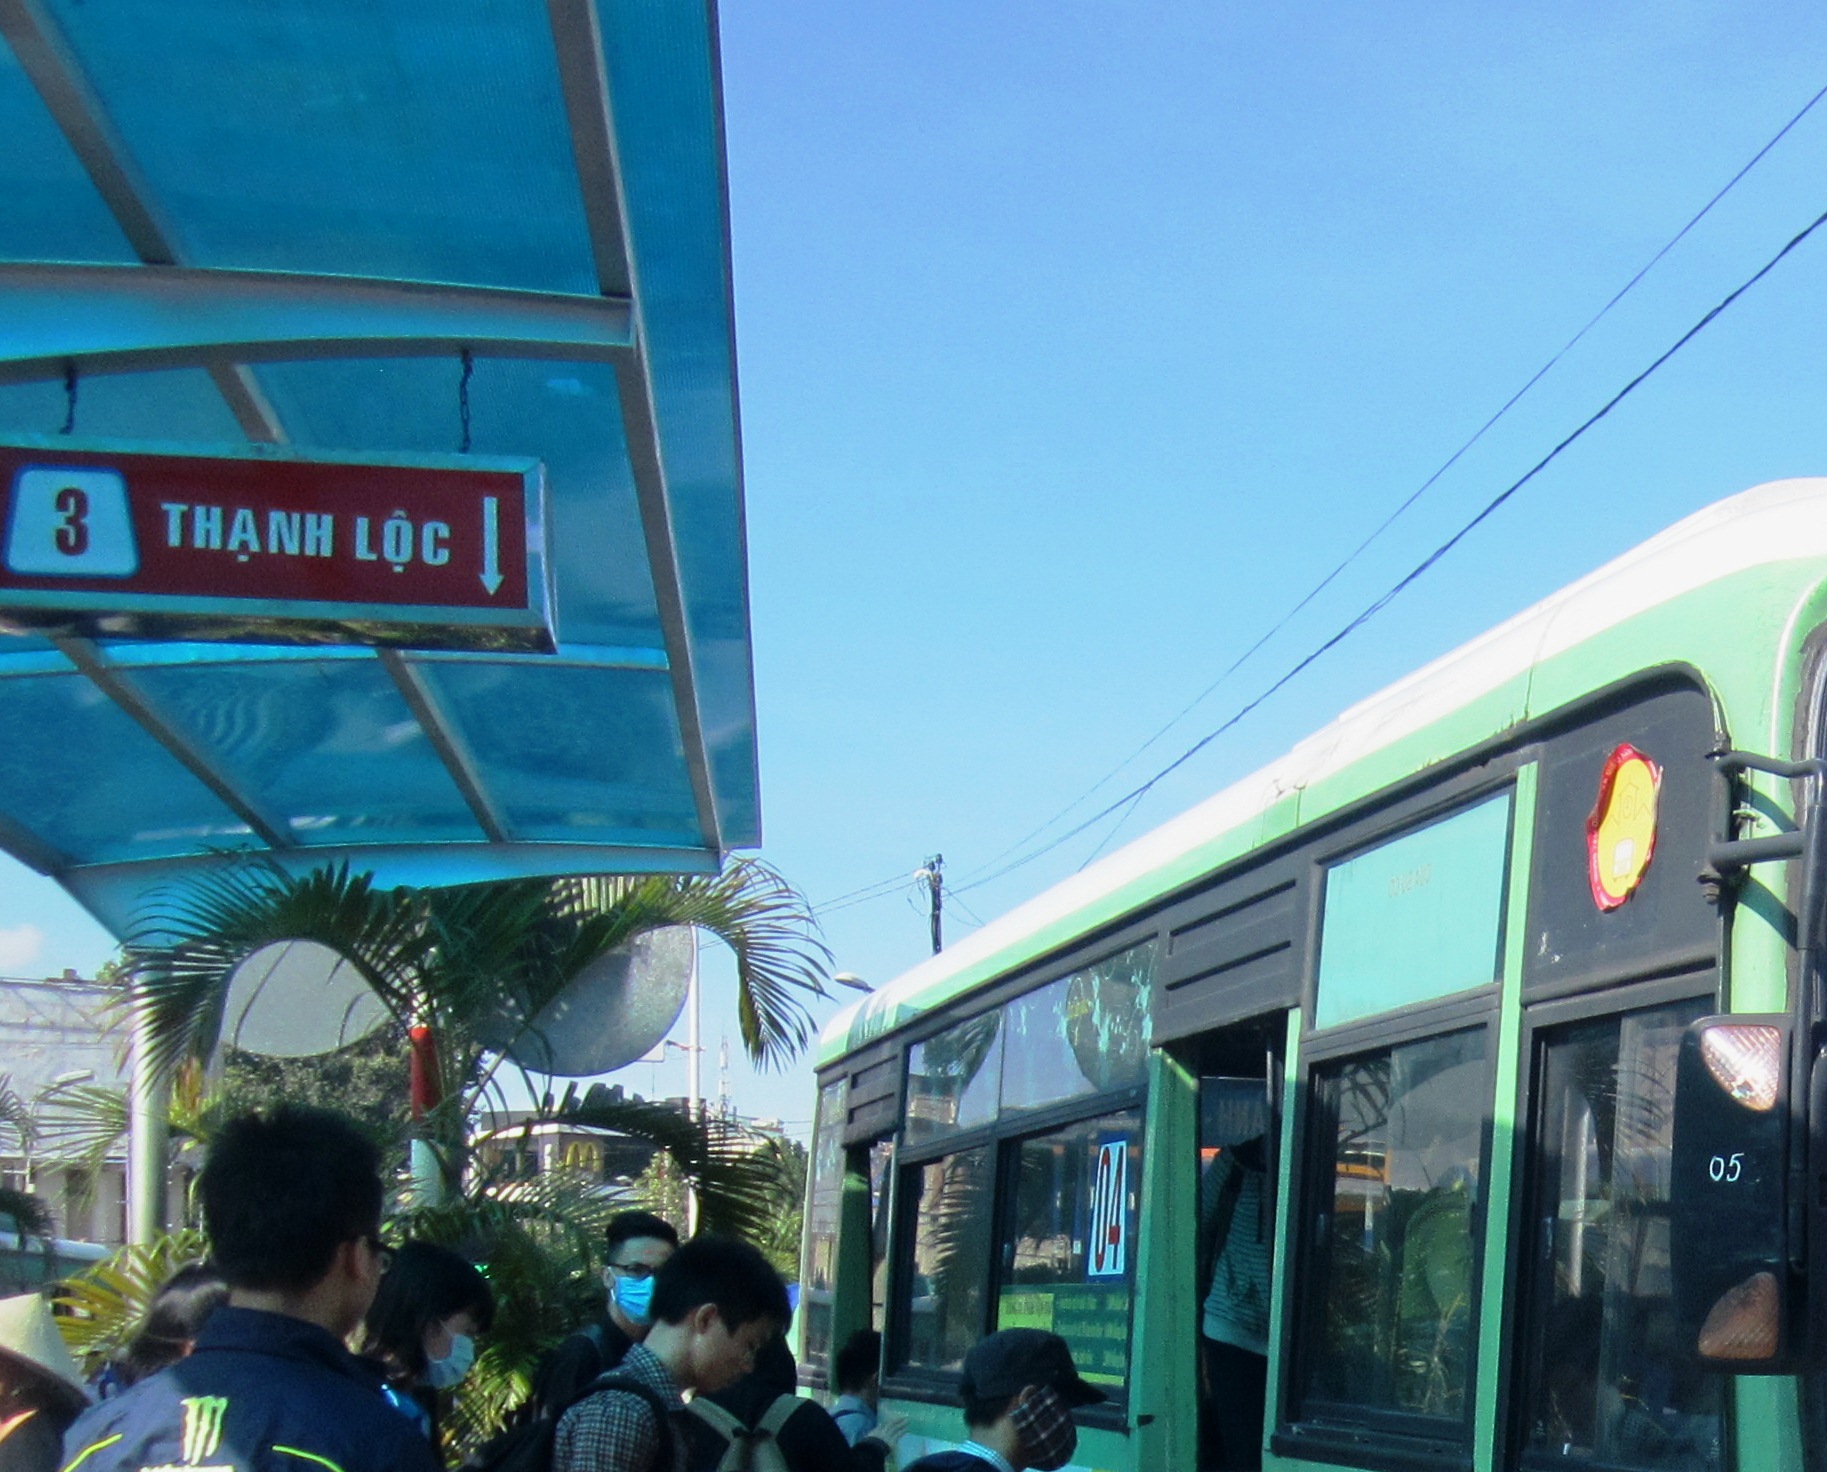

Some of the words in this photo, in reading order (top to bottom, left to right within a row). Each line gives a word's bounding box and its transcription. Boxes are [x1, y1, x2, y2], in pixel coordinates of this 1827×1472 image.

[55, 488, 88, 556] 3
[159, 502, 334, 562] THẠNH
[355, 509, 451, 573] LỘC
[1095, 1146, 1123, 1272] 04
[1709, 1152, 1744, 1182] 05
